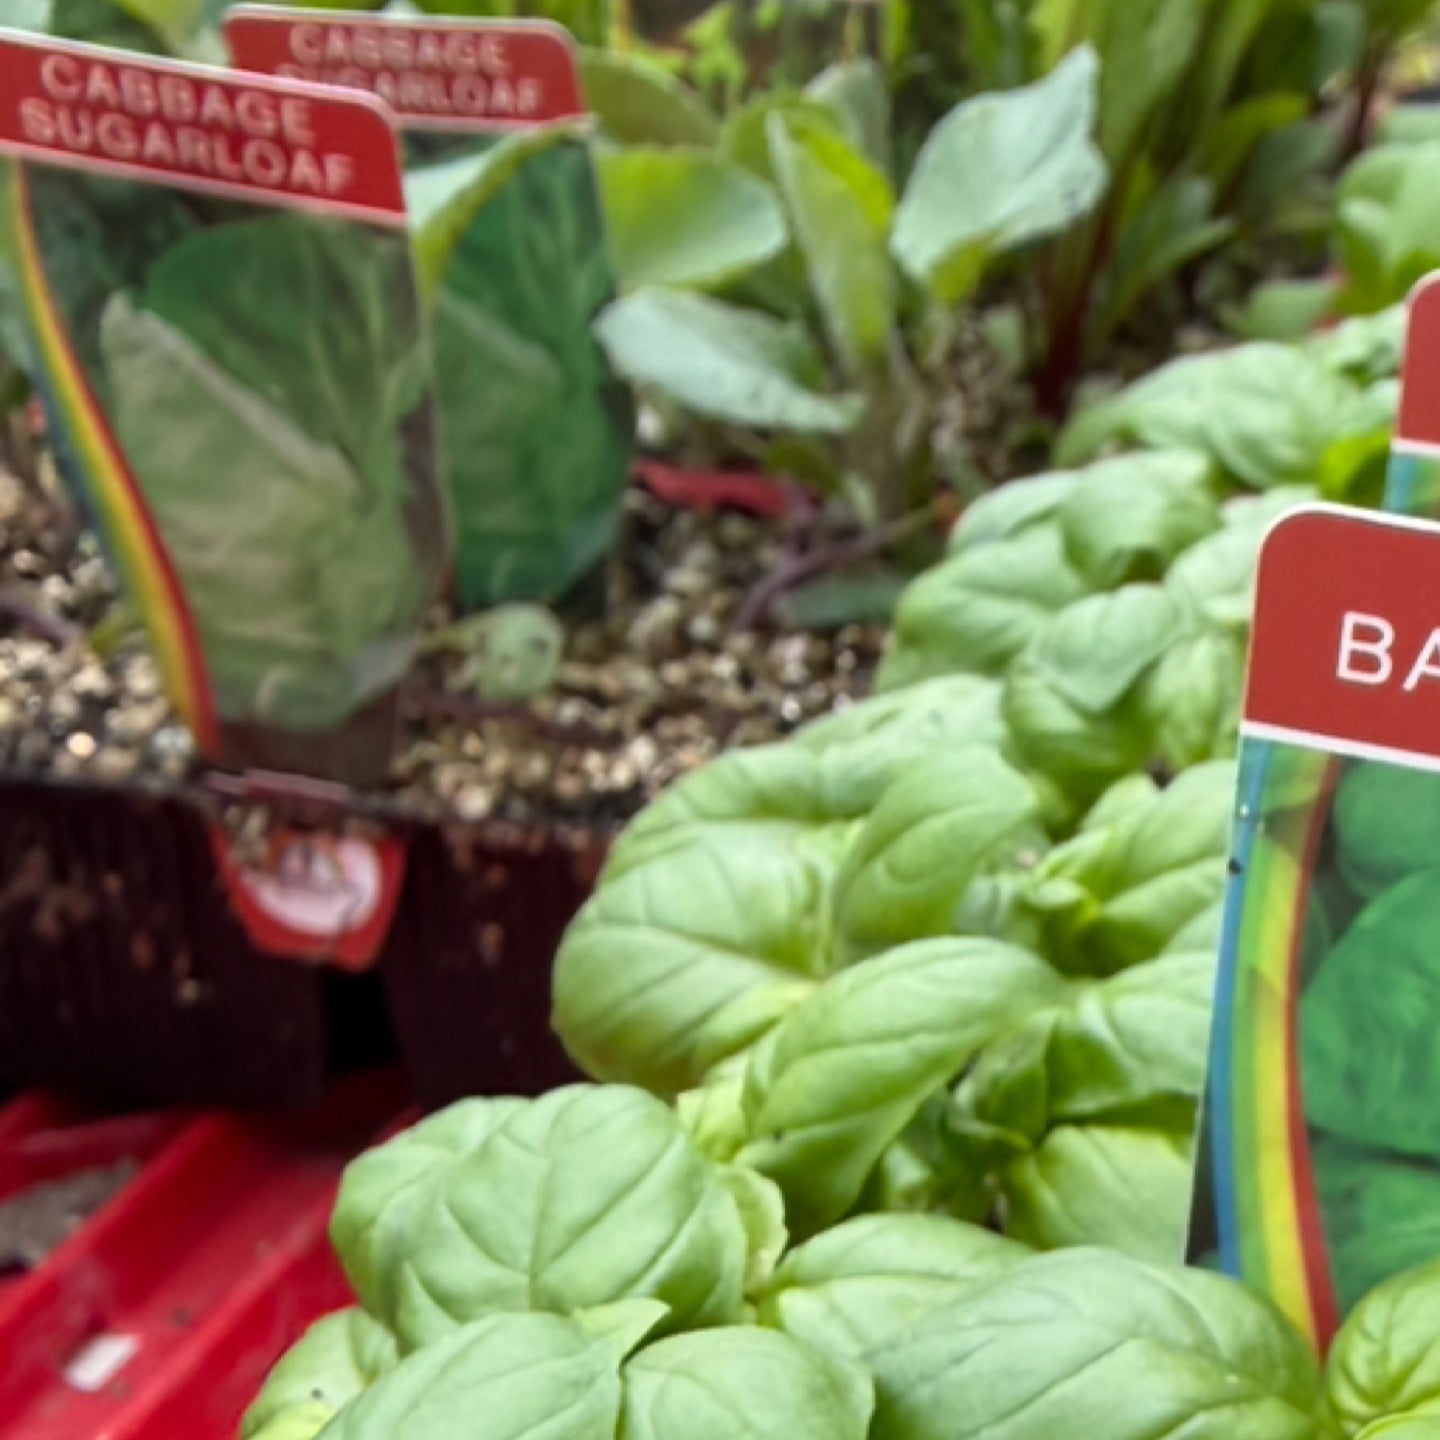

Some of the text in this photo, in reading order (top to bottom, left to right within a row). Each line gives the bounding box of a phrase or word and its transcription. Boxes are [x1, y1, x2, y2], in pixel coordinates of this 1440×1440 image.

[289, 22, 508, 77] CABBAGE
[19, 97, 354, 197] SUGARLOAF
[40, 53, 316, 147] CABBAGE
